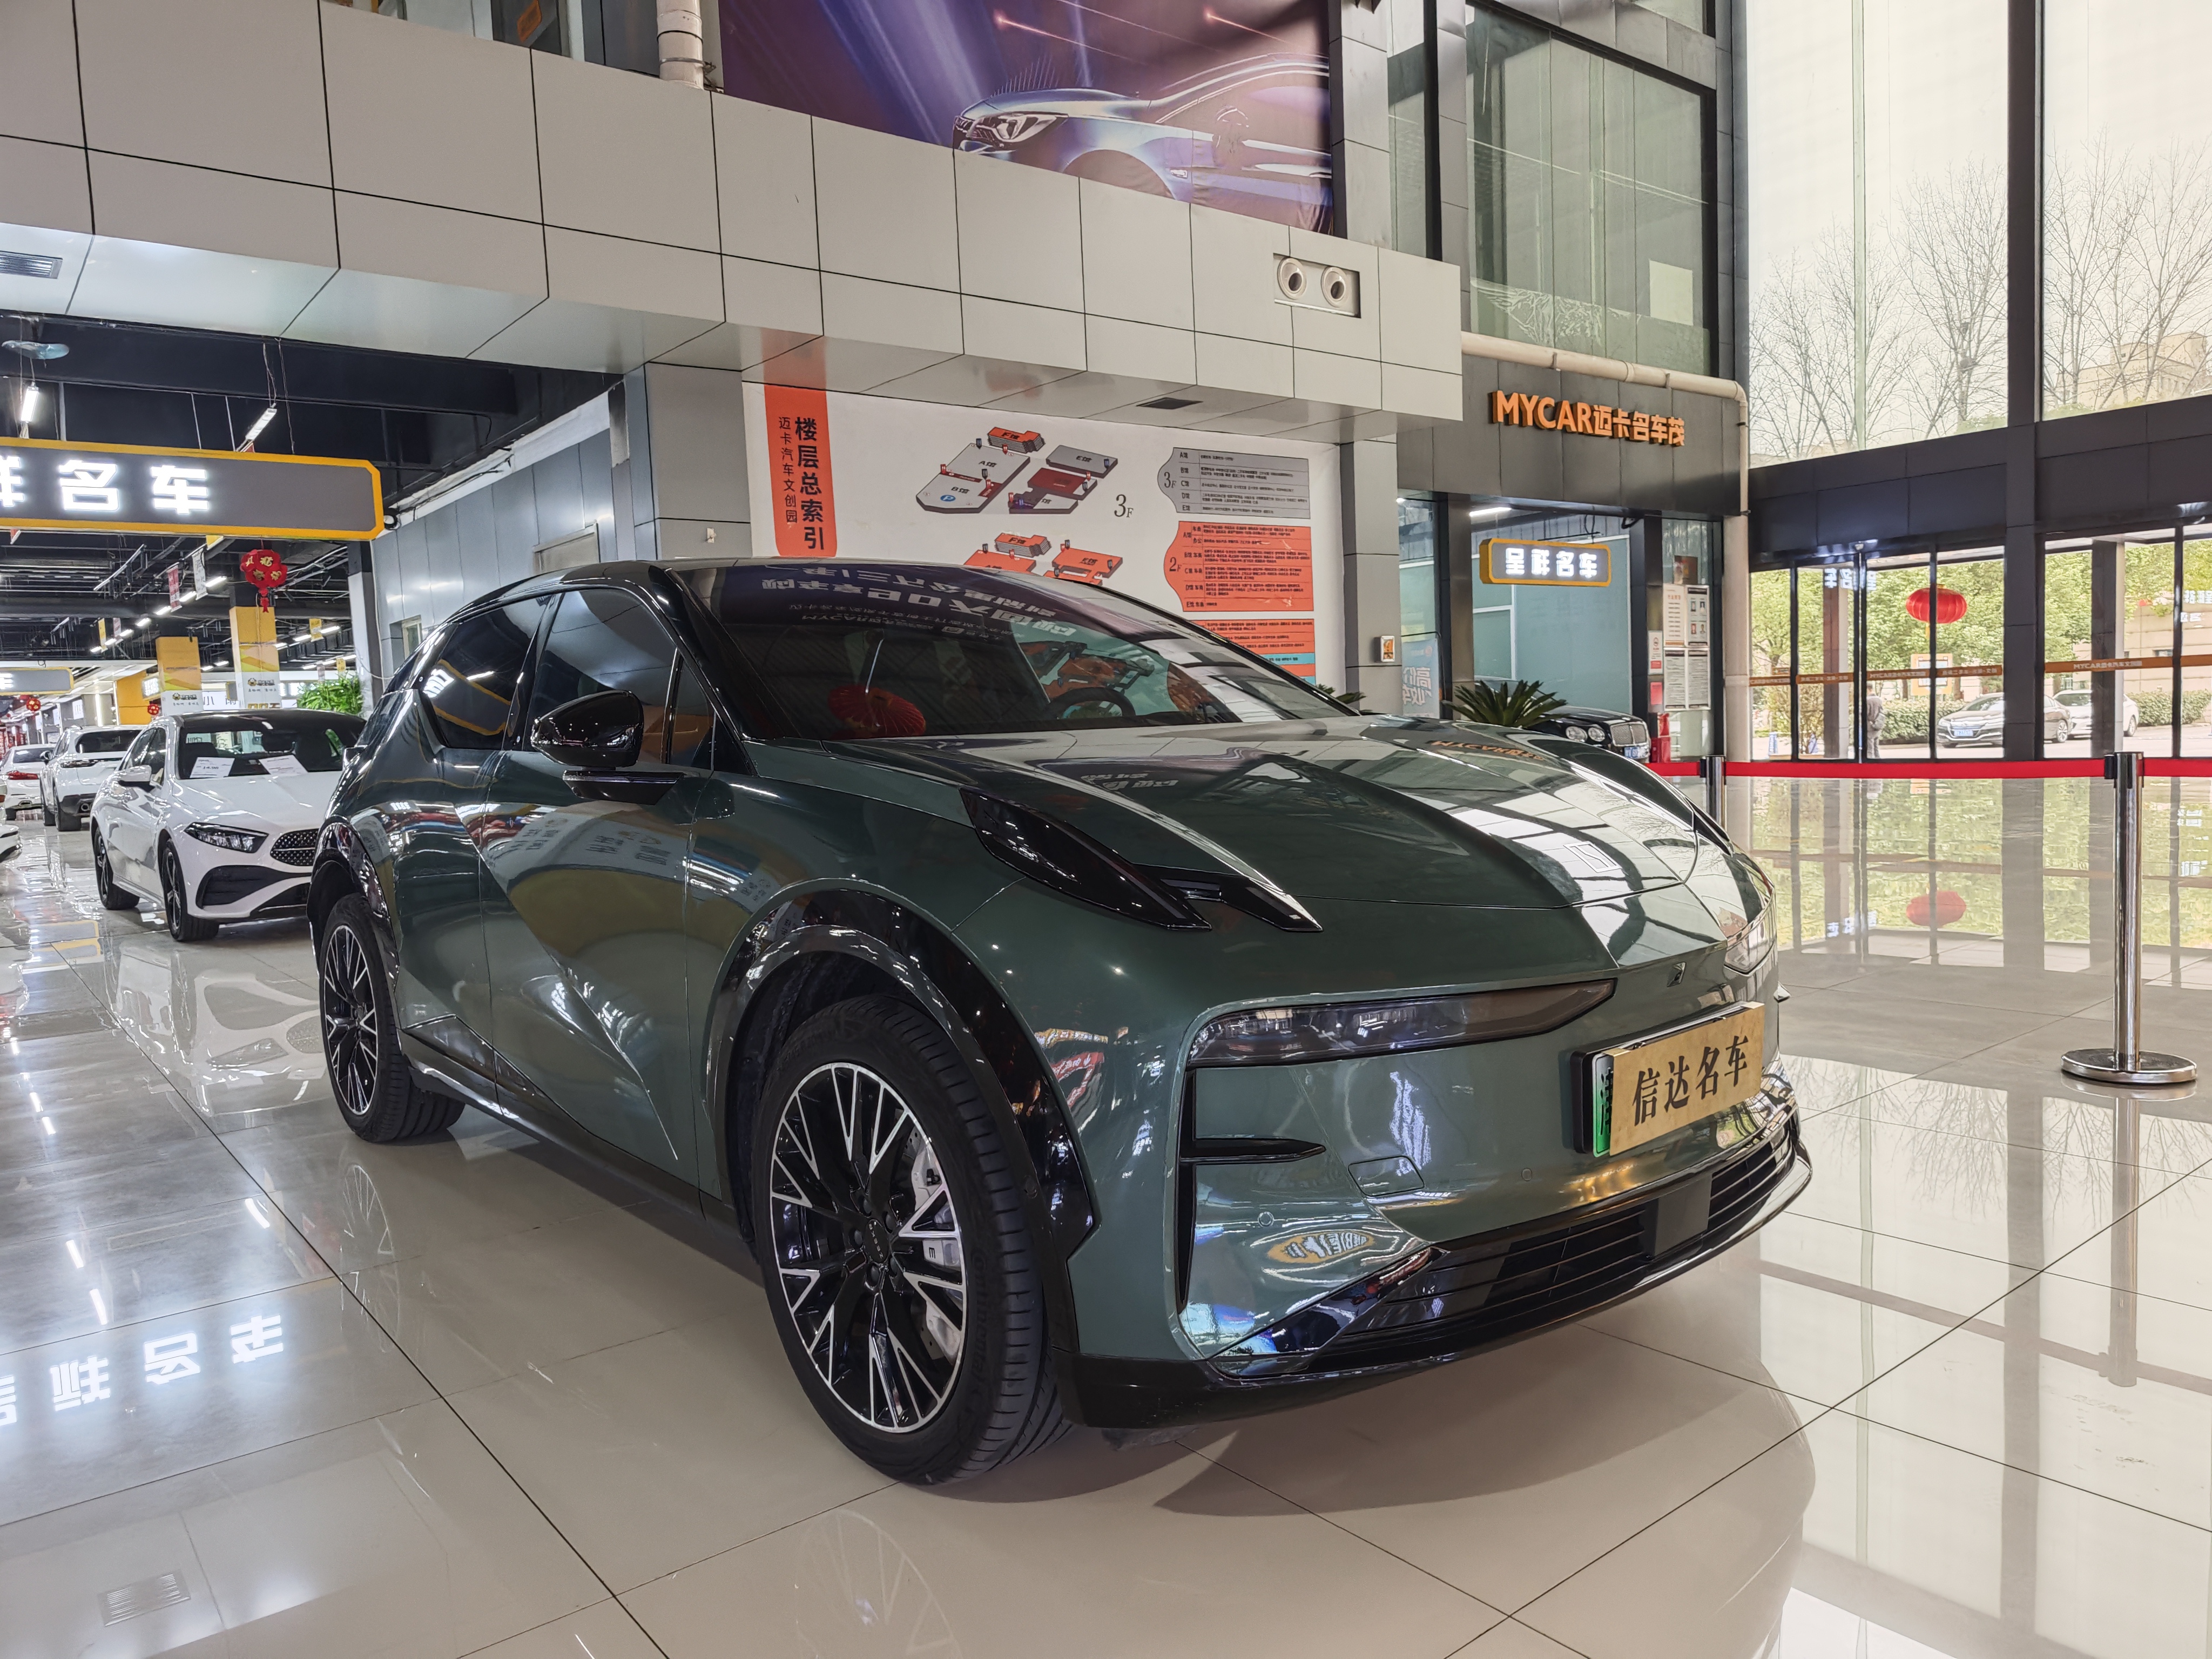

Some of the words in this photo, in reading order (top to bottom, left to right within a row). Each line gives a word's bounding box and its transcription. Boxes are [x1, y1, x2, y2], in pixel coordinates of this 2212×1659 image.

[778, 416, 798, 523] 迈卡汽车文创园
[795, 416, 825, 550] 楼层总索引
[1505, 547, 1597, 578] 呈祥名车
[1631, 1035, 1749, 1127] 信达名车
[868, 1223, 884, 1259] ZEEKR
